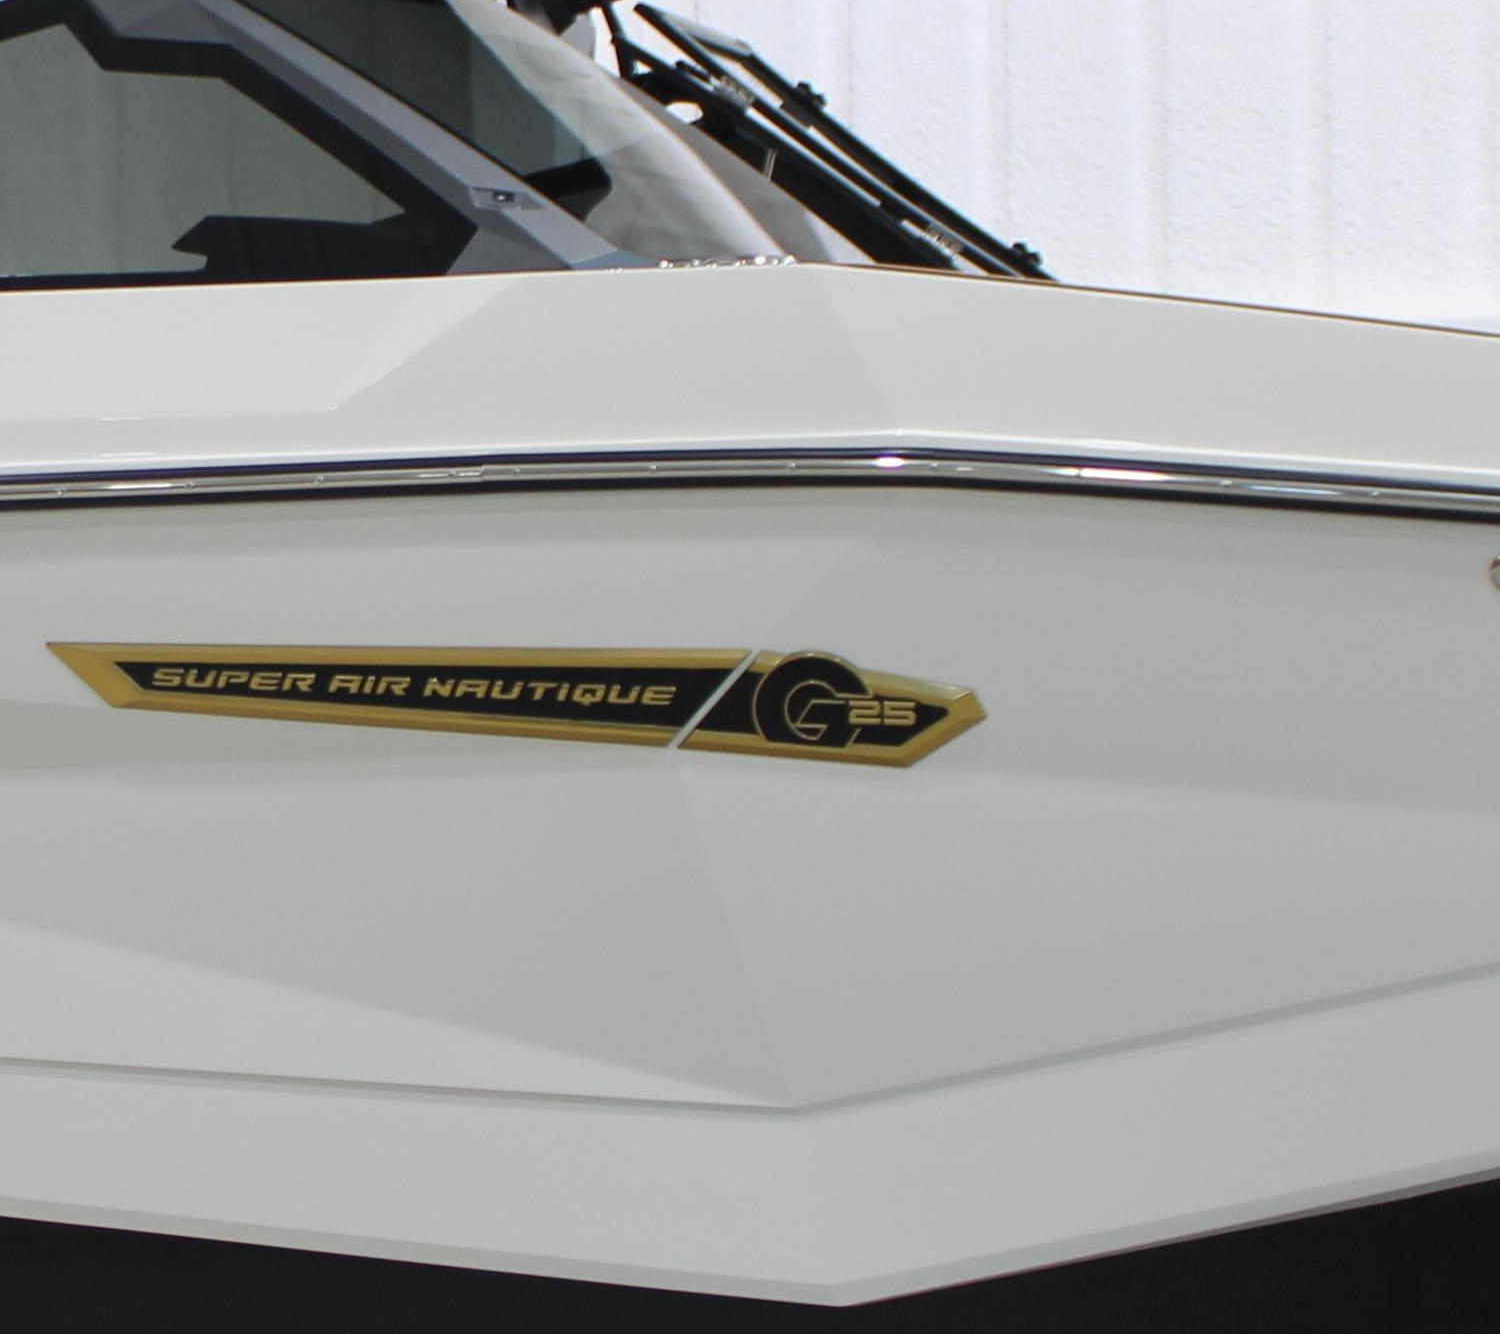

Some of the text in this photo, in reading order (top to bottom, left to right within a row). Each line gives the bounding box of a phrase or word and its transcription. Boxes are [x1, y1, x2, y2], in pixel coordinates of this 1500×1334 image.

[152, 668, 677, 706] SUPER AIR NAUTIQUE
